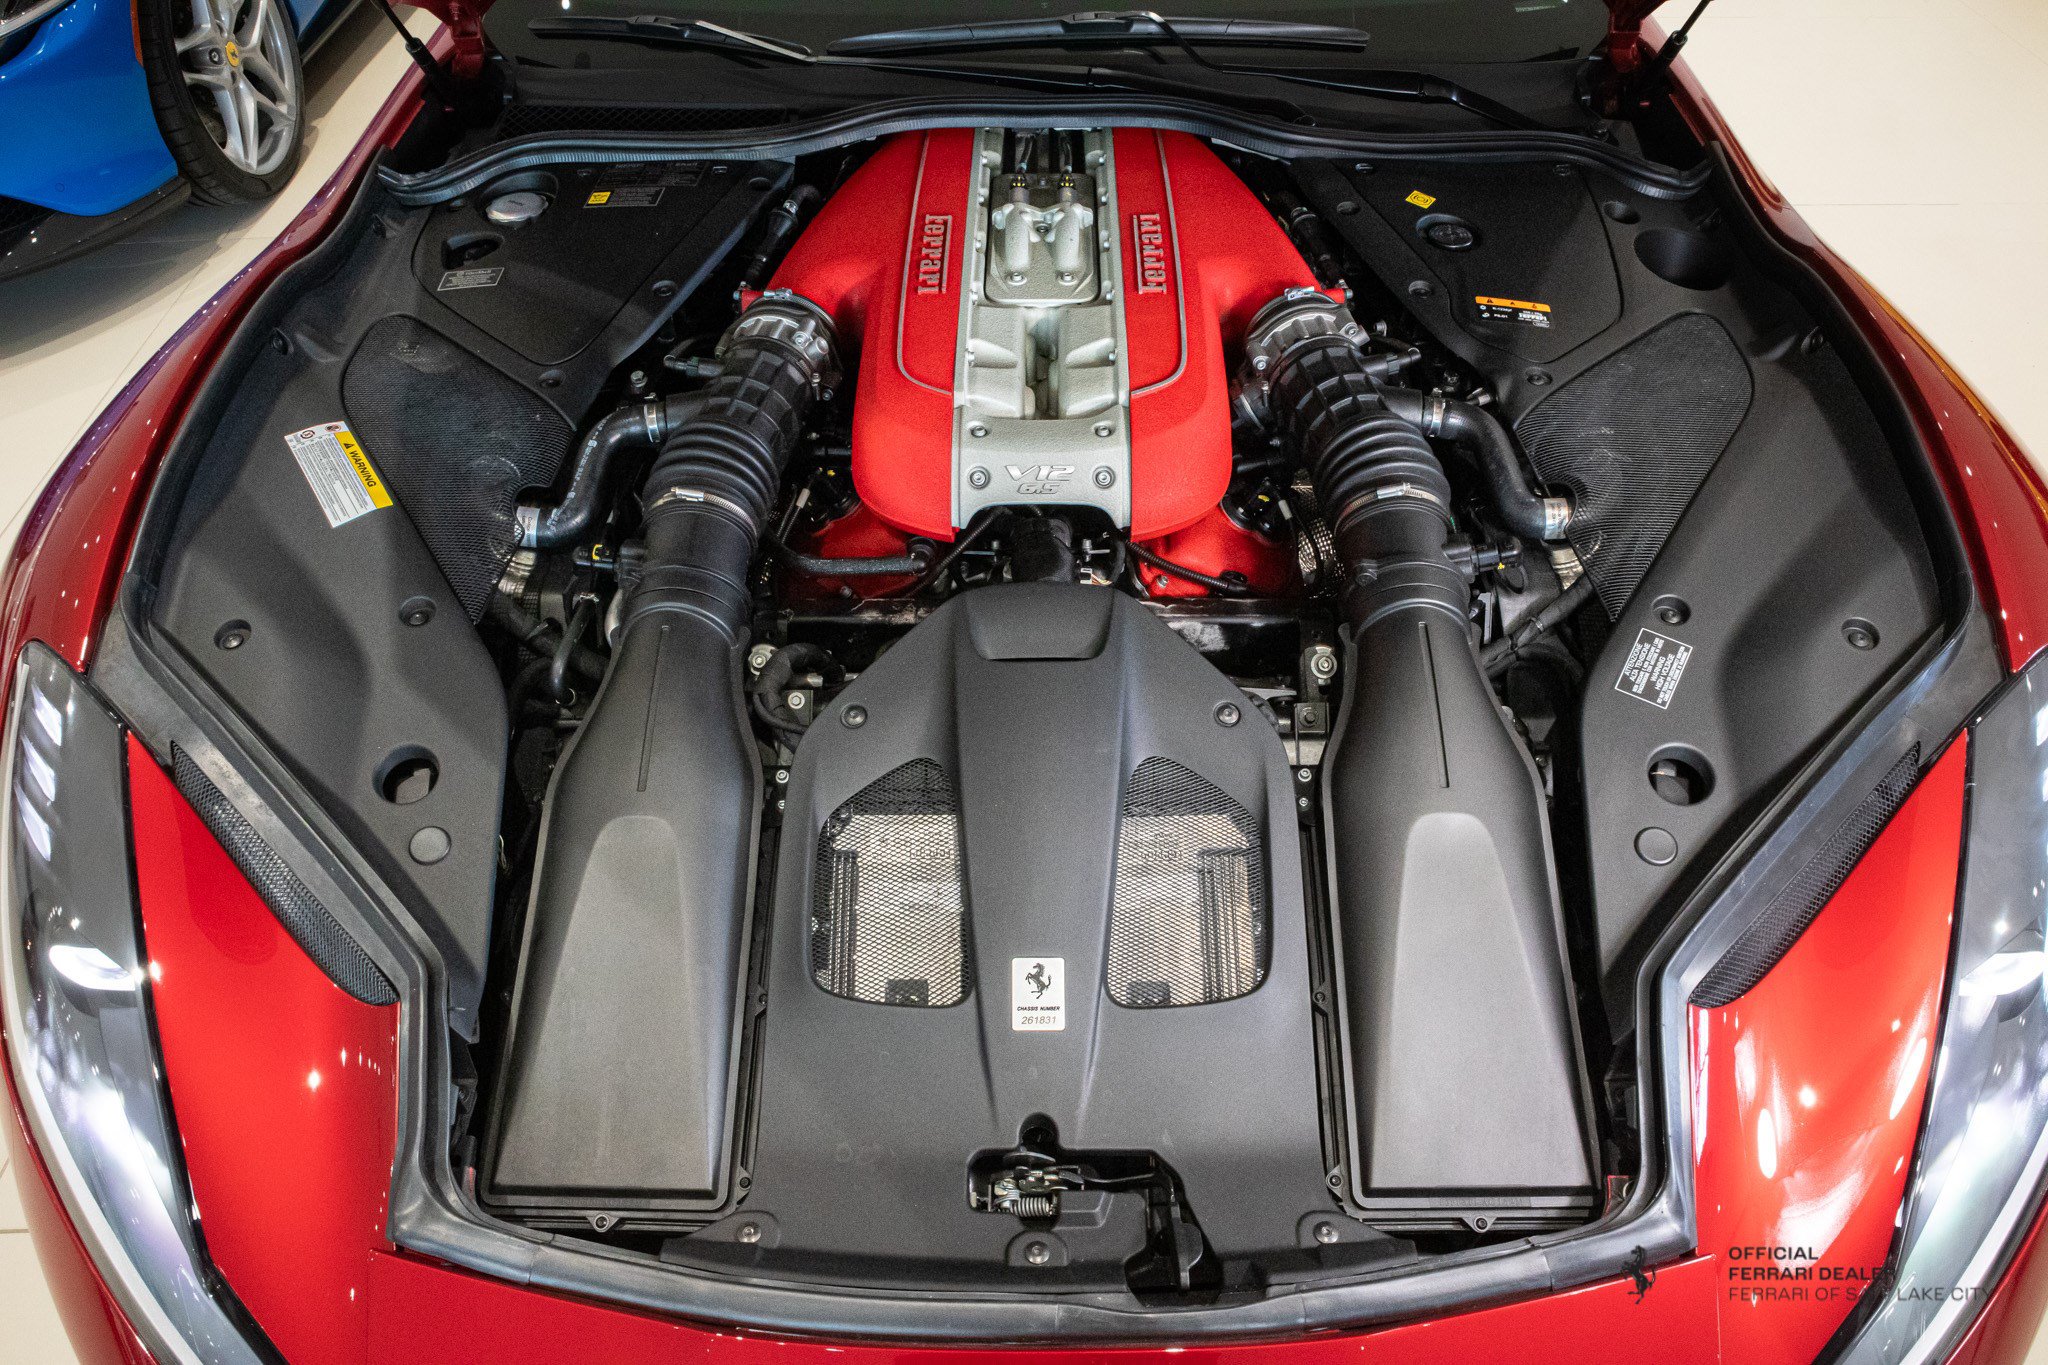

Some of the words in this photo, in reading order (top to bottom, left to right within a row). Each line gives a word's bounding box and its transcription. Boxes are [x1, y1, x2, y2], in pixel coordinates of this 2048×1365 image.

[349, 450, 376, 488] WARNING
[1004, 465, 1075, 481] V12
[1624, 643, 1643, 676] ATTENZIONE
[1635, 642, 1651, 668] TENSIONE
[1661, 653, 1676, 676] VOLTAGE
[1650, 656, 1666, 682] WARNING
[1021, 1016, 1056, 1025] 261831
